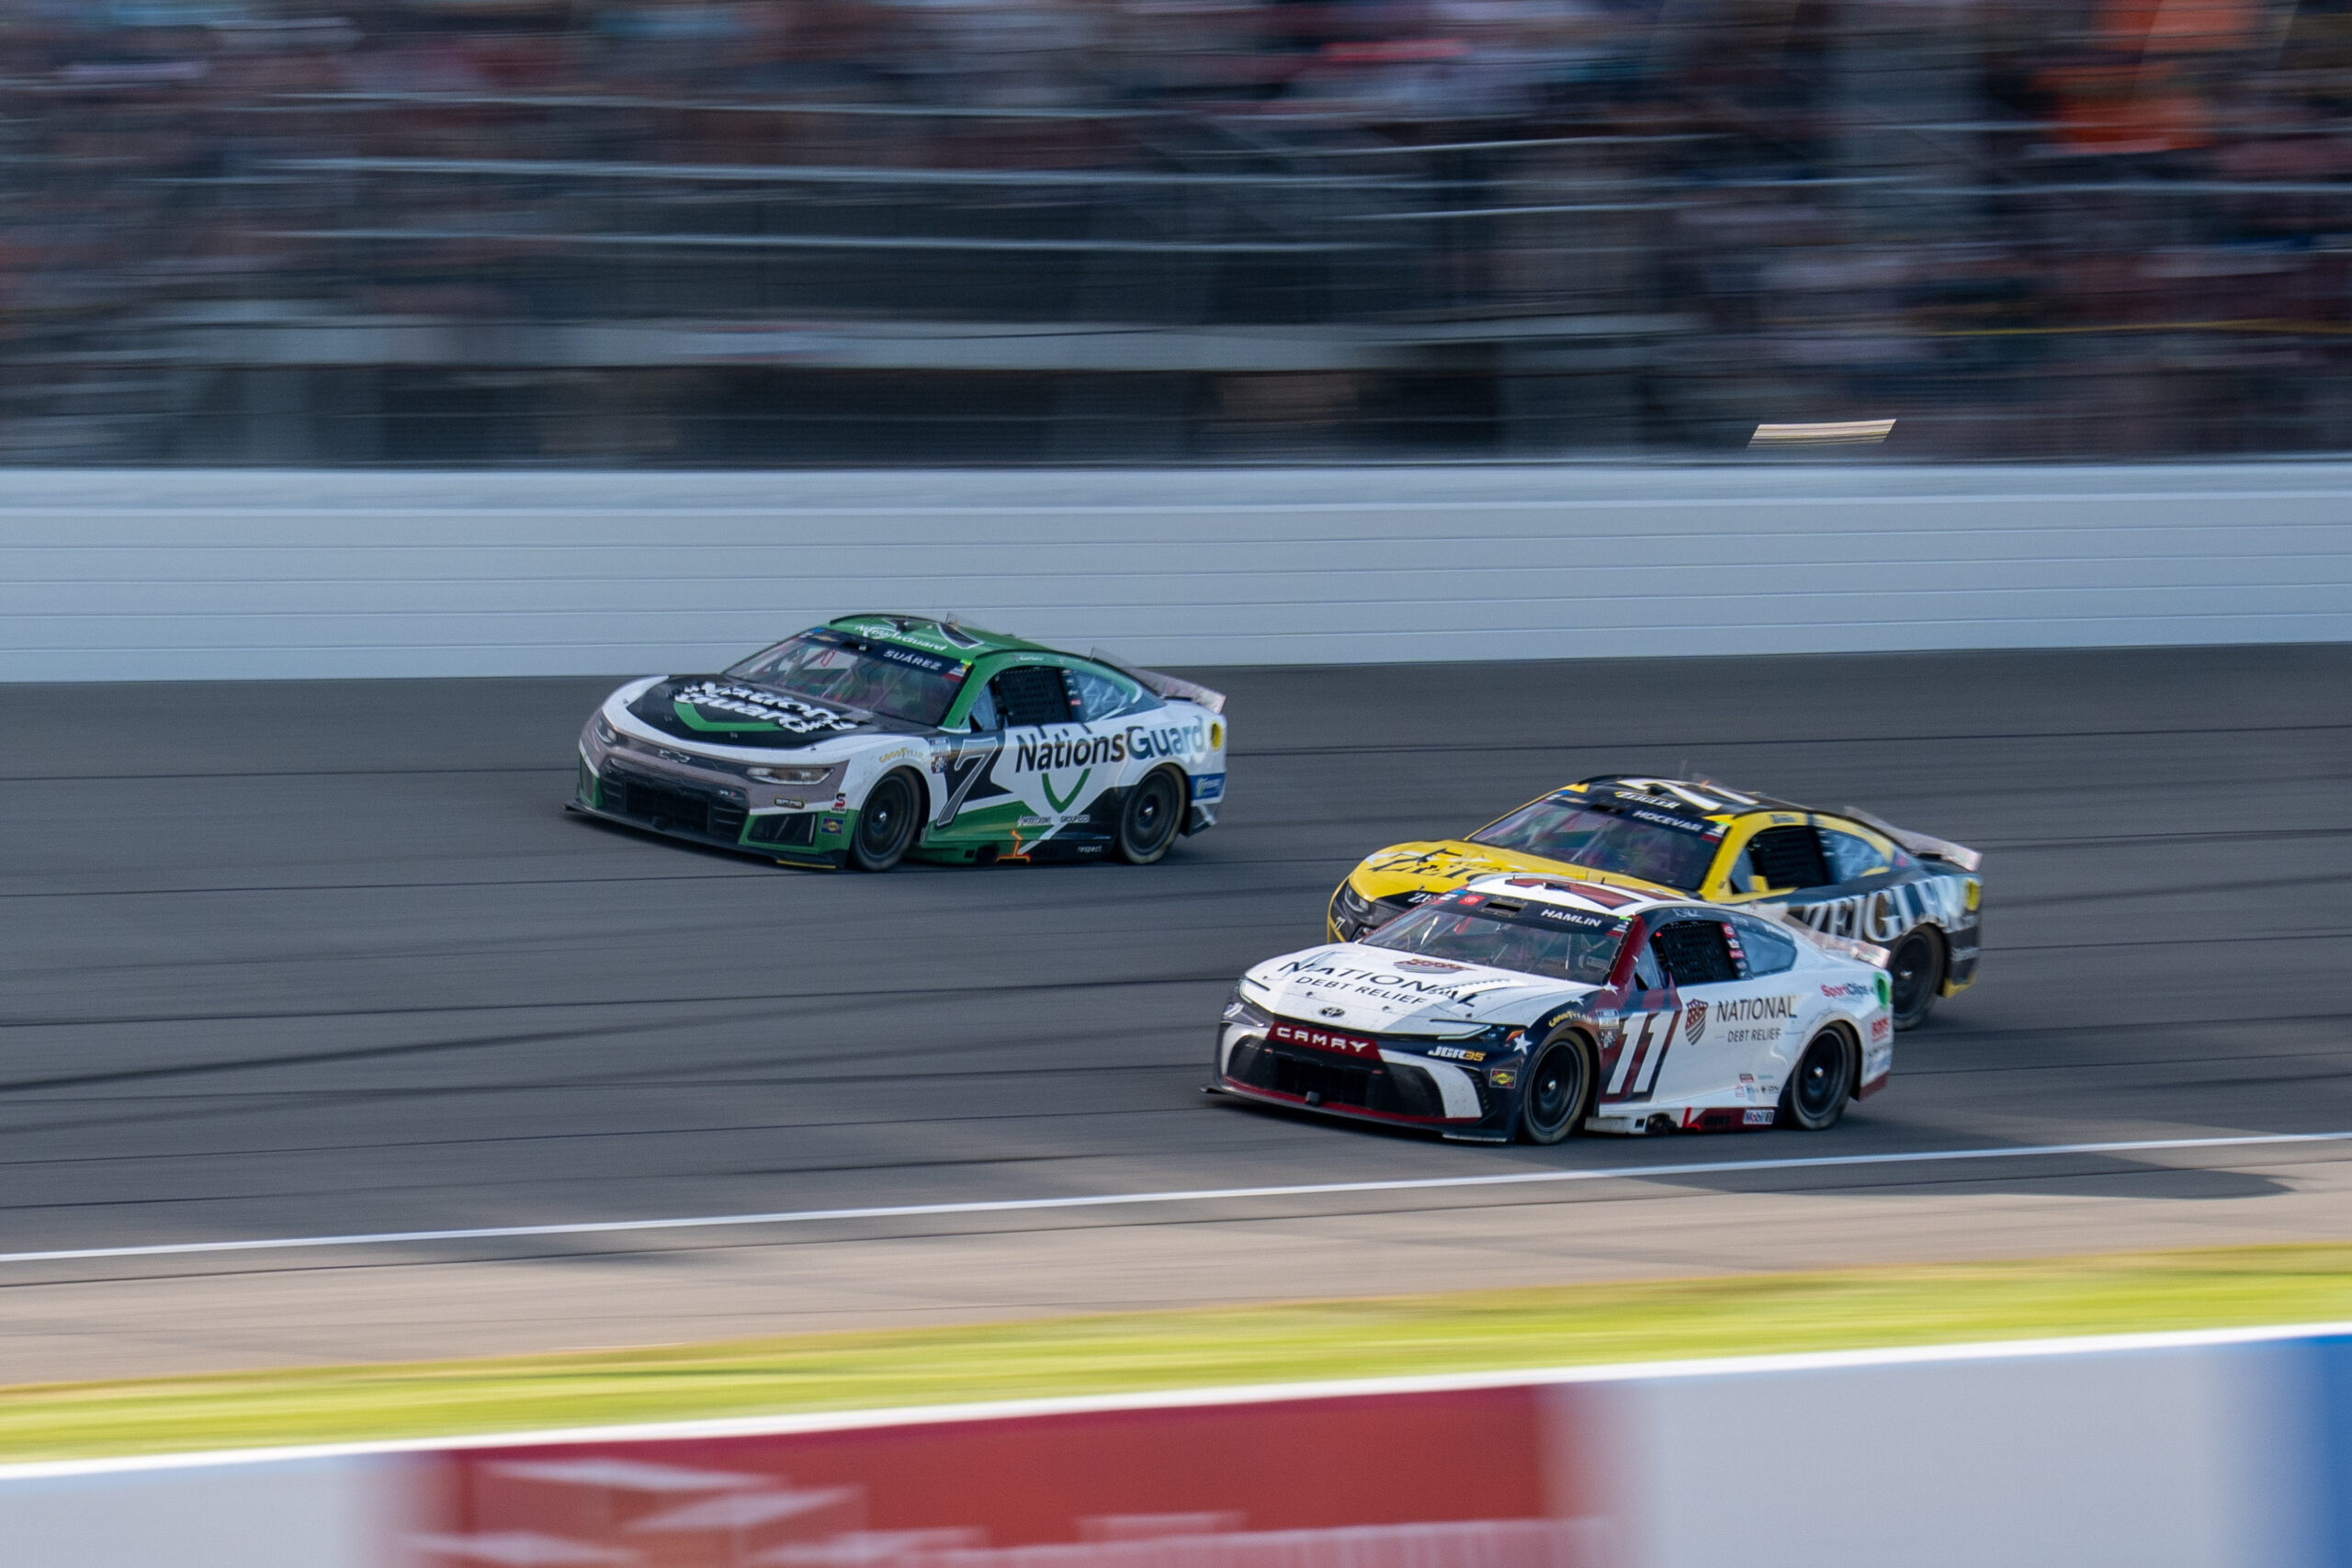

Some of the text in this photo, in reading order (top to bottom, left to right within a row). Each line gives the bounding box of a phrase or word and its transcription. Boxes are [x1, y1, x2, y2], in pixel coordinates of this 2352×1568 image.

[883, 649, 943, 671] SUÁREZ
[937, 737, 999, 827] 7
[1633, 809, 1703, 831] HOCEVAR
[1541, 908, 1601, 928] HAMLIN
[1278, 962, 1478, 1008] NATIONAL
[1295, 976, 1429, 1005] DEBT RELIEF
[1716, 995, 1798, 1022] NATIONAL
[1276, 1026, 1370, 1052] CAMRY
[1728, 1028, 1781, 1043] DEBT RELIEF
[1606, 1011, 1678, 1095] 11
